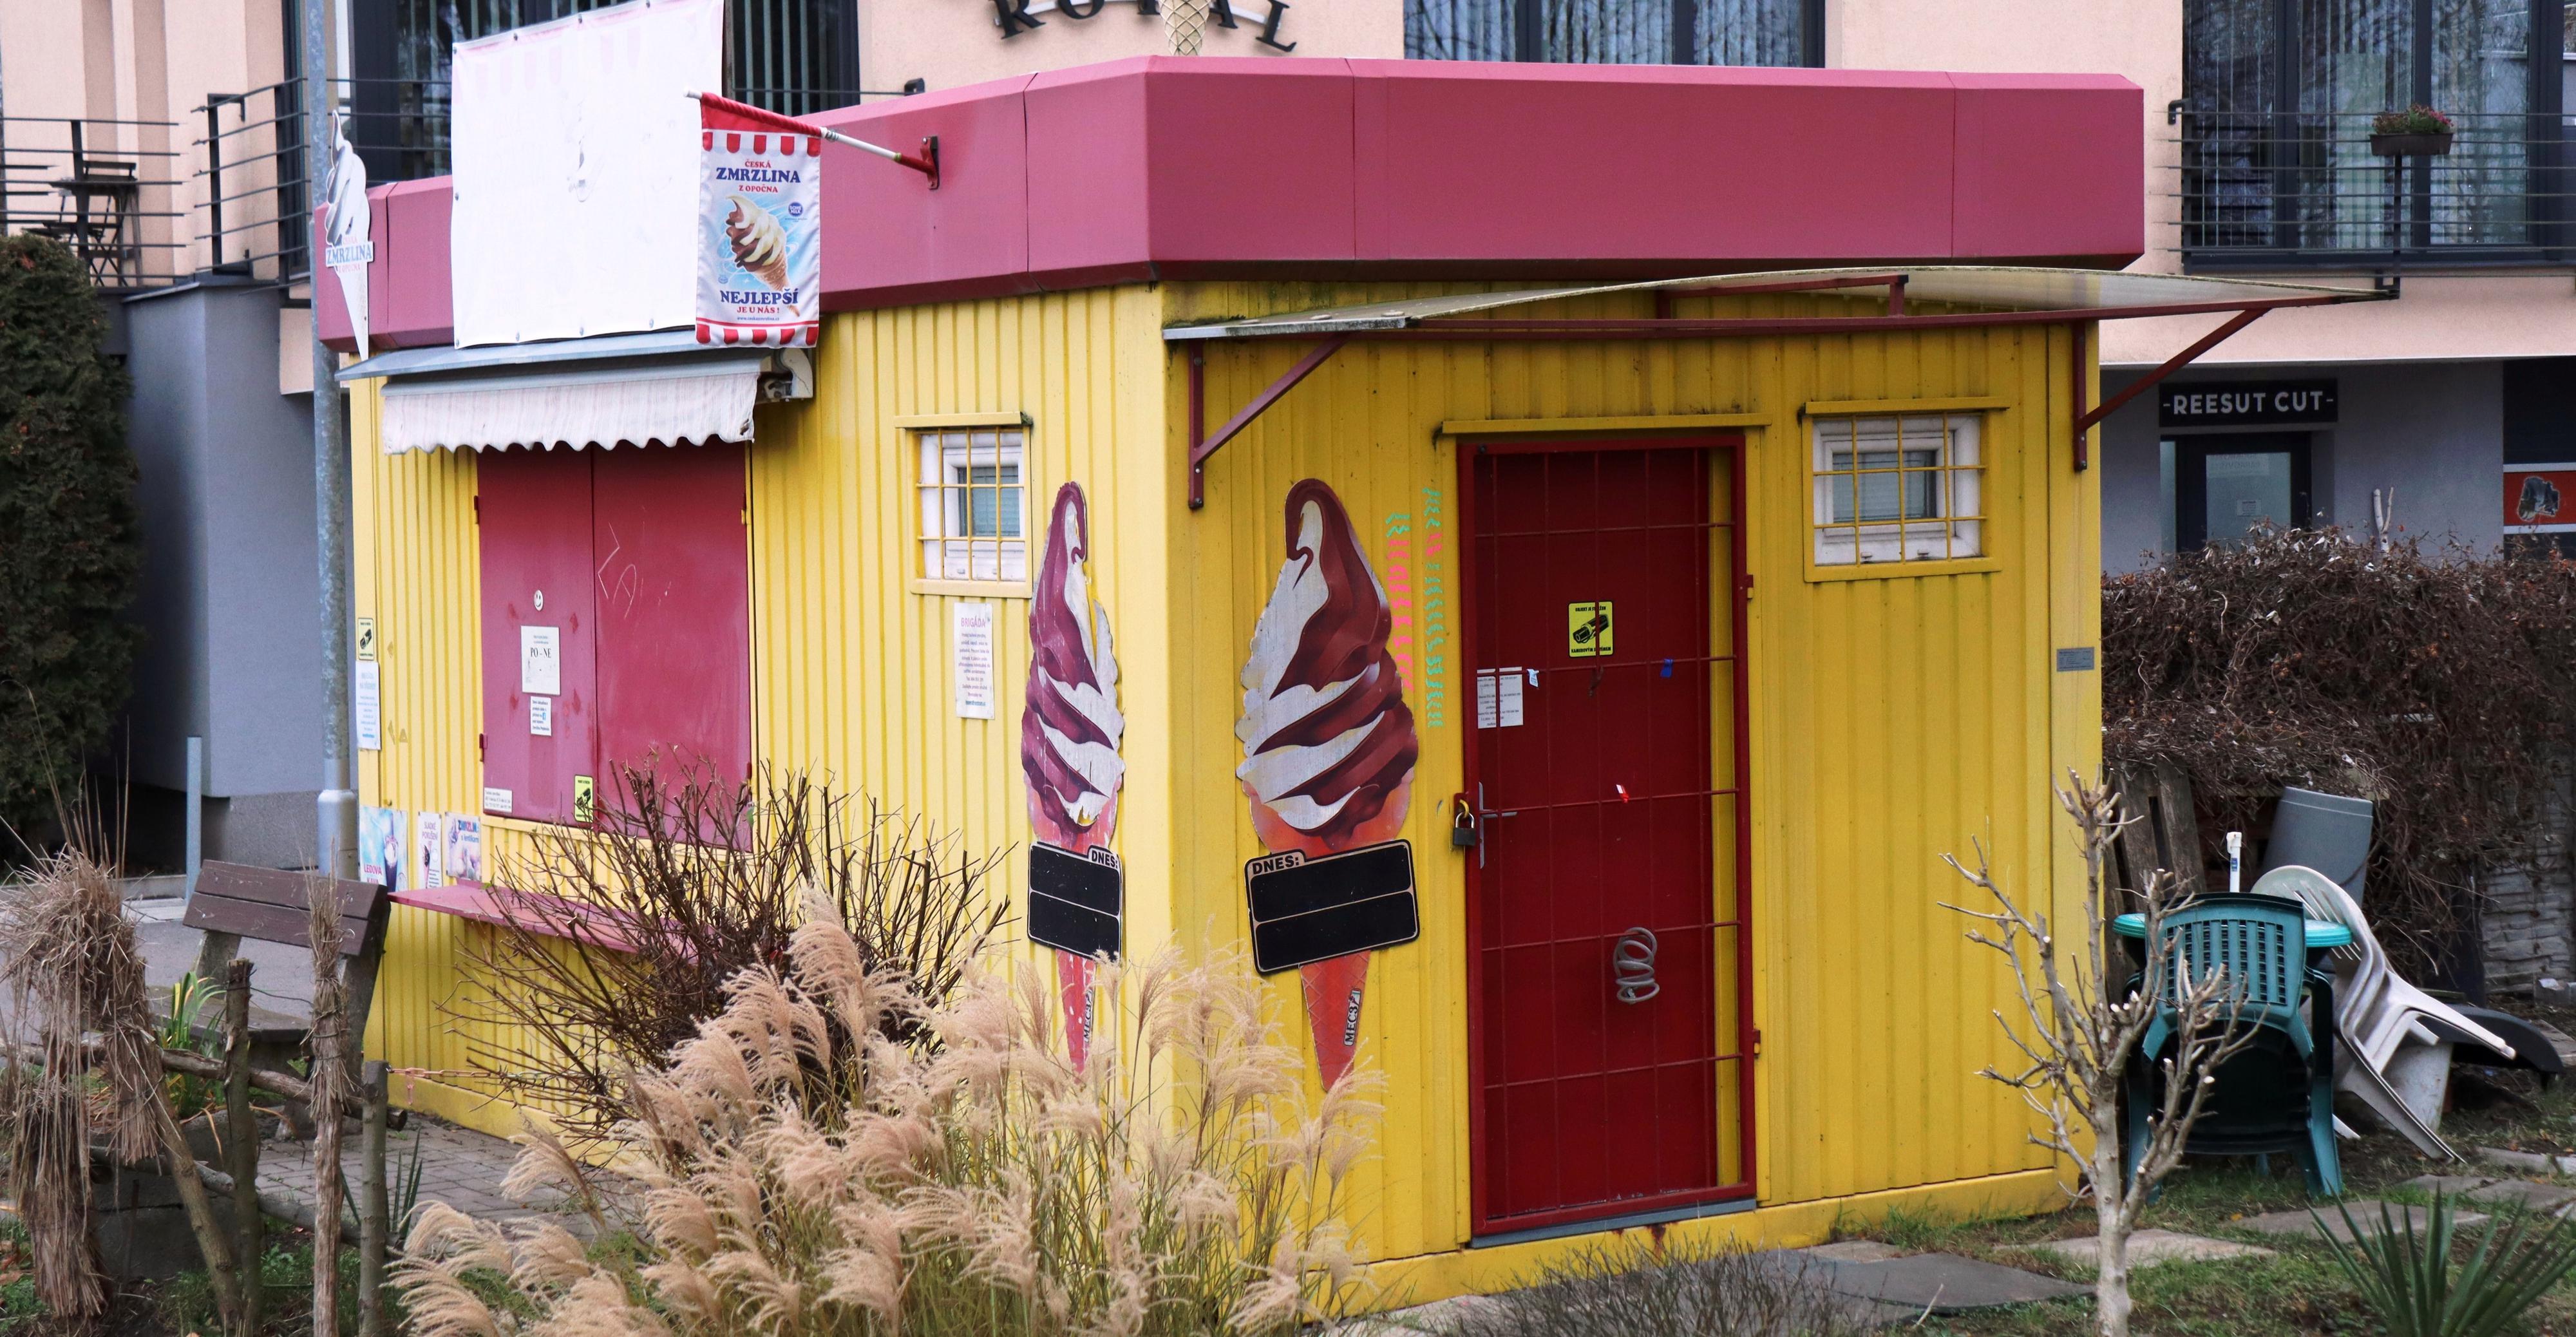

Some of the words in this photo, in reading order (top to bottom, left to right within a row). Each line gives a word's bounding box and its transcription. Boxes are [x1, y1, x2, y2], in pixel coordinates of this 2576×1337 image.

[744, 159, 771, 168] ČESKÁ
[716, 167, 800, 183] ZMRZLINA
[745, 184, 778, 193] OPOČNA
[327, 244, 372, 265] ZMRZLINA
[720, 288, 799, 305] NEJLEPŠÍ
[757, 305, 775, 314] NÁS
[961, 615, 986, 628] BRIGÁDA
[531, 647, 538, 658] PO
[543, 648, 552, 658] NE
[1092, 849, 1118, 869] DNES:
[1252, 855, 1300, 875] DNES:
[1345, 1006, 1358, 1042] MEC3
